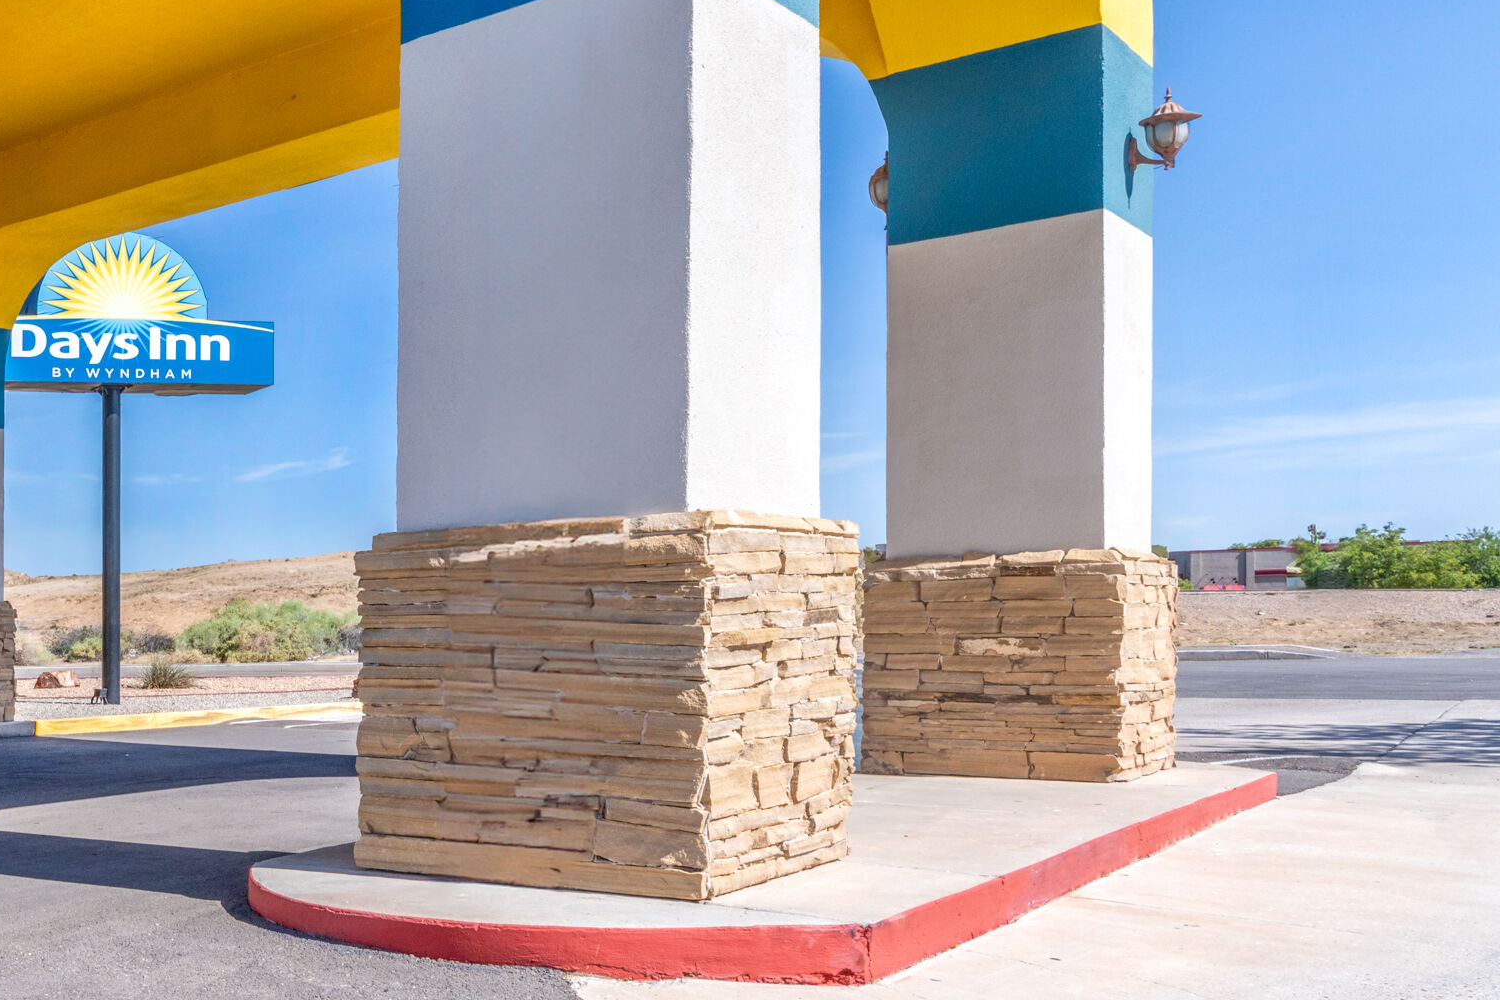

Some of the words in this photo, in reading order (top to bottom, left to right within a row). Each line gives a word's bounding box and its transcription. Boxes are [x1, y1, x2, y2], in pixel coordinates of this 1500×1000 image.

[11, 323, 140, 365] Days
[149, 326, 230, 361] Inn
[52, 367, 75, 378] BY
[86, 368, 192, 379] WYNDHAM
